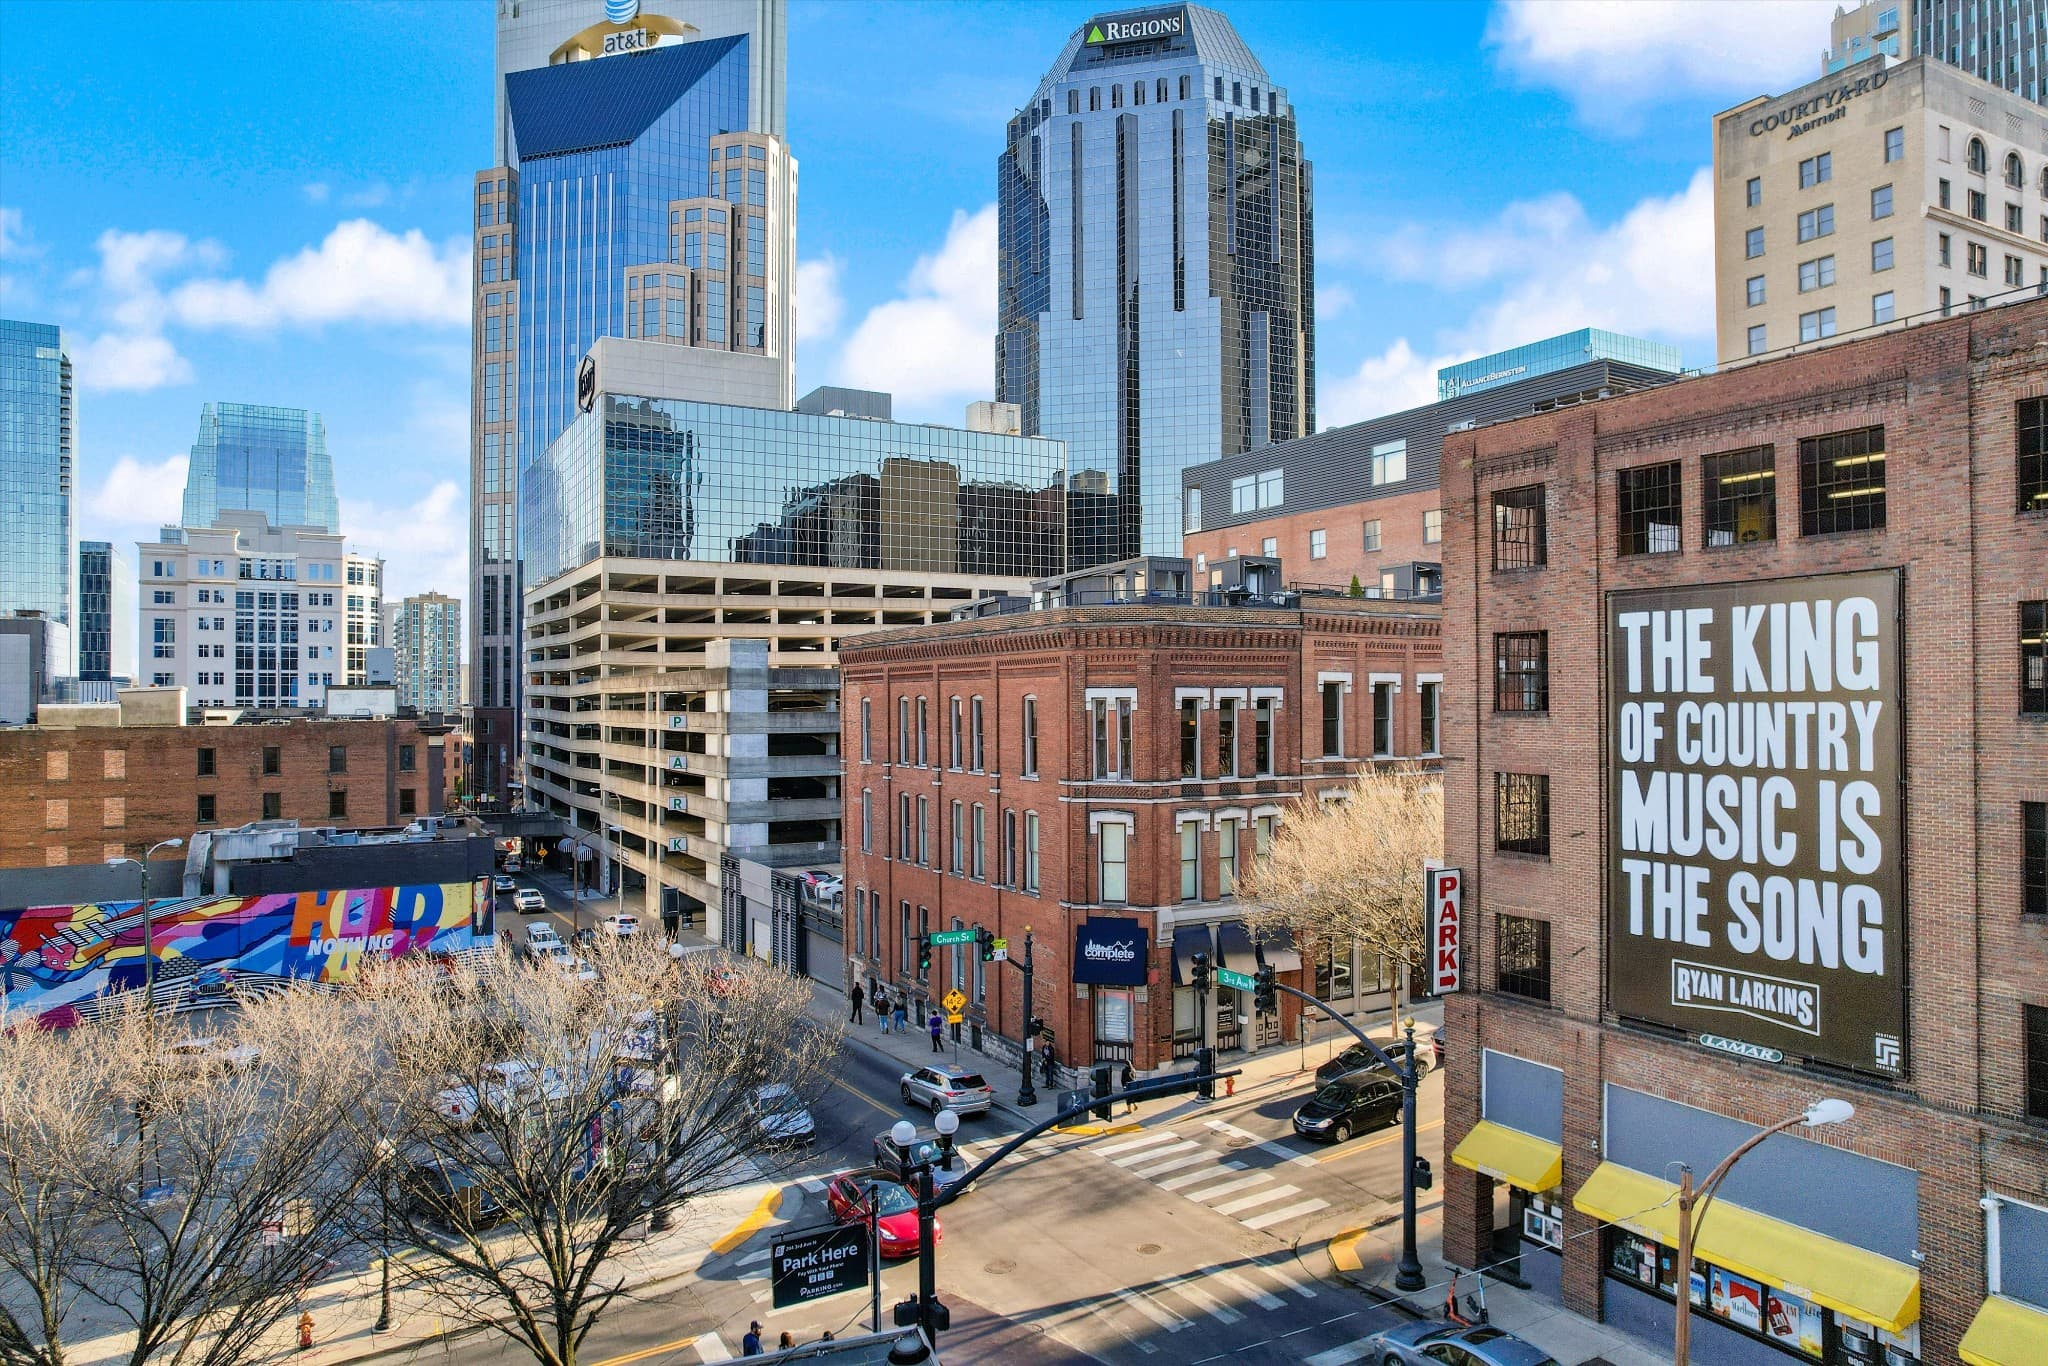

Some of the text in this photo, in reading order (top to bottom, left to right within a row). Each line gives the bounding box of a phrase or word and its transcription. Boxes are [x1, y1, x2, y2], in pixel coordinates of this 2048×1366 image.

[604, 28, 646, 54] at&t
[1106, 16, 1180, 41] REGIONS
[1749, 70, 1889, 137] COURTYARD
[1787, 105, 1846, 140] Marriott
[1618, 596, 1880, 694] THE KING
[1620, 700, 1882, 772] OF COUNTRY
[1620, 769, 1882, 875] MUSIC IS
[1438, 876, 1458, 972] PARK
[1621, 859, 1884, 977] THE SONG
[307, 933, 394, 956] NOTHING
[936, 932, 970, 944] Church St
[1085, 948, 1135, 960] complete
[1236, 977, 1248, 989] Ave
[1677, 966, 1814, 1027] RYAN LARKINS
[1705, 1036, 1773, 1061] LAMAR
[783, 1244, 858, 1272] Park Here
